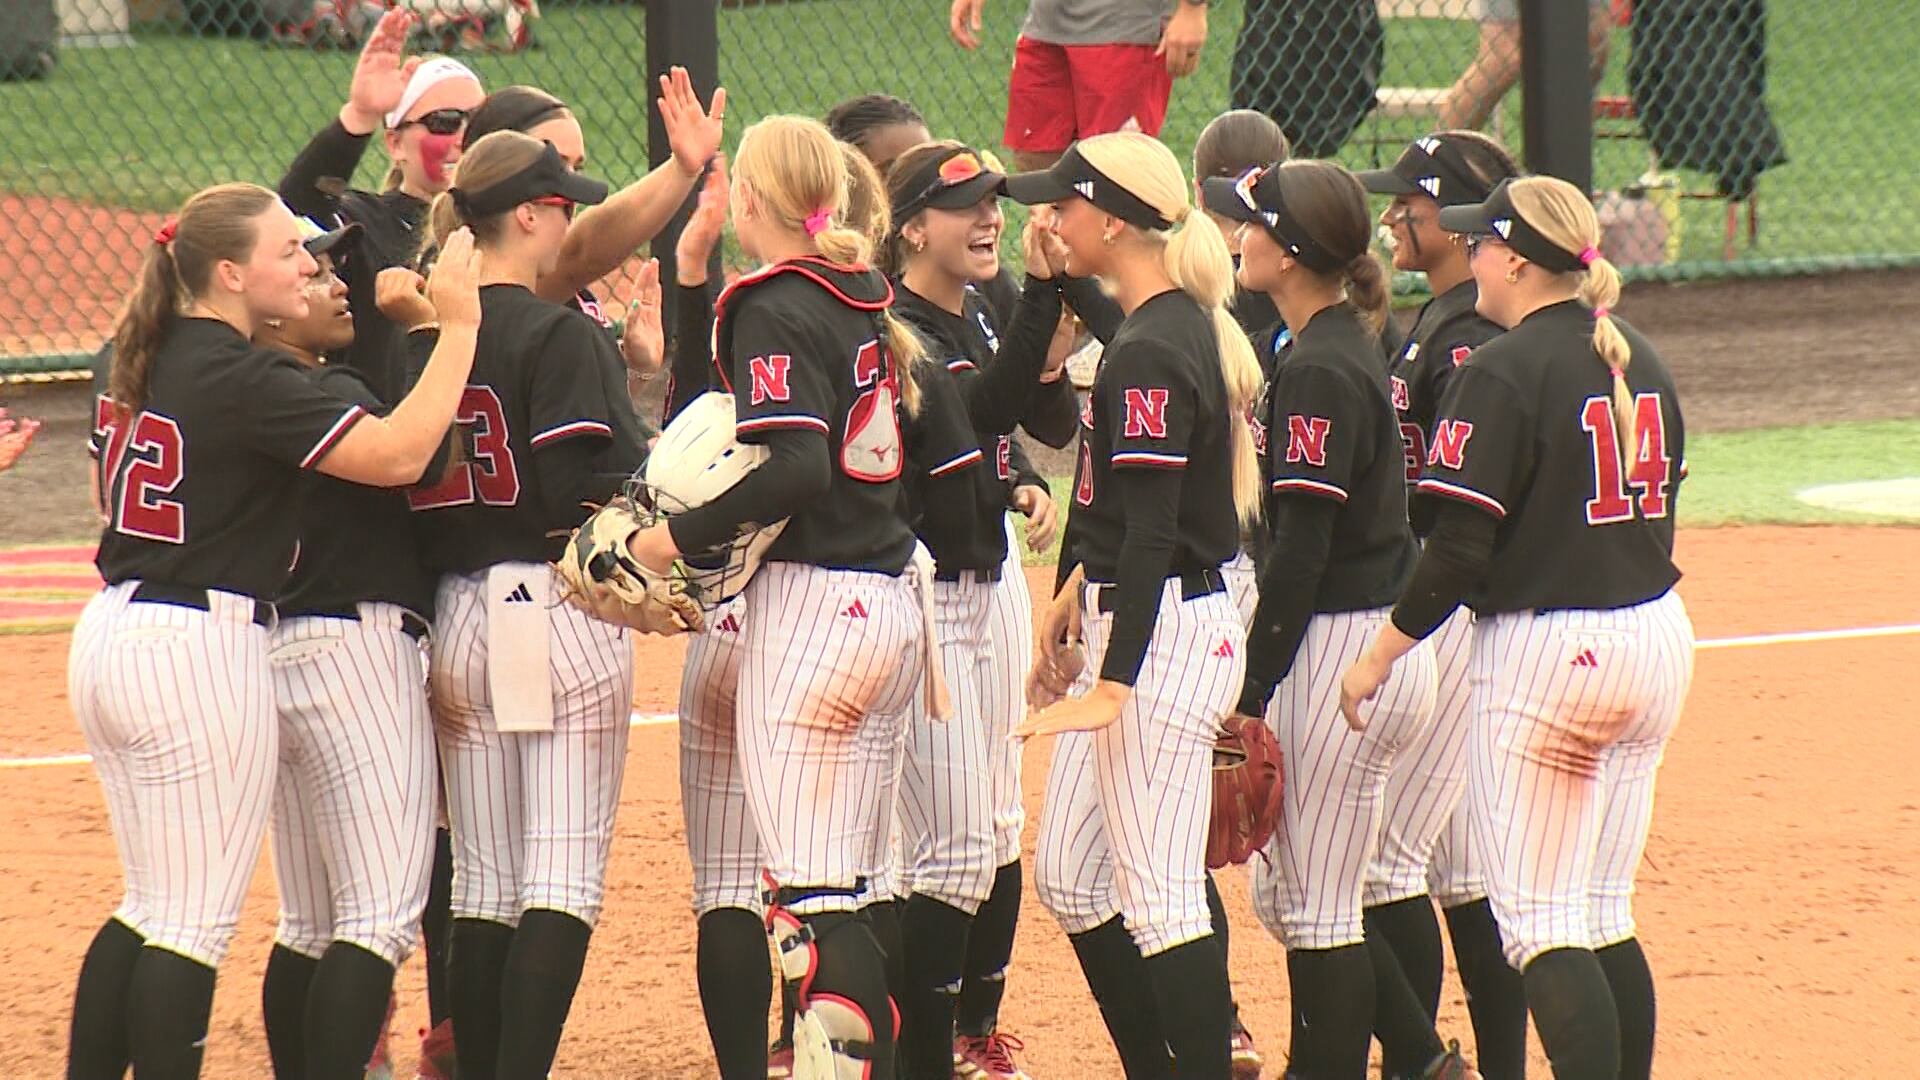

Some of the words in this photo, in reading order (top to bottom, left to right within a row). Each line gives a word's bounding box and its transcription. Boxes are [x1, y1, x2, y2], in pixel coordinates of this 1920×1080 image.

[750, 355, 791, 406] N
[1125, 389, 1169, 438] N
[1286, 415, 1330, 466] N
[1427, 419, 1473, 469] N
[1581, 393, 1671, 525] 14
[95, 393, 185, 544] 72
